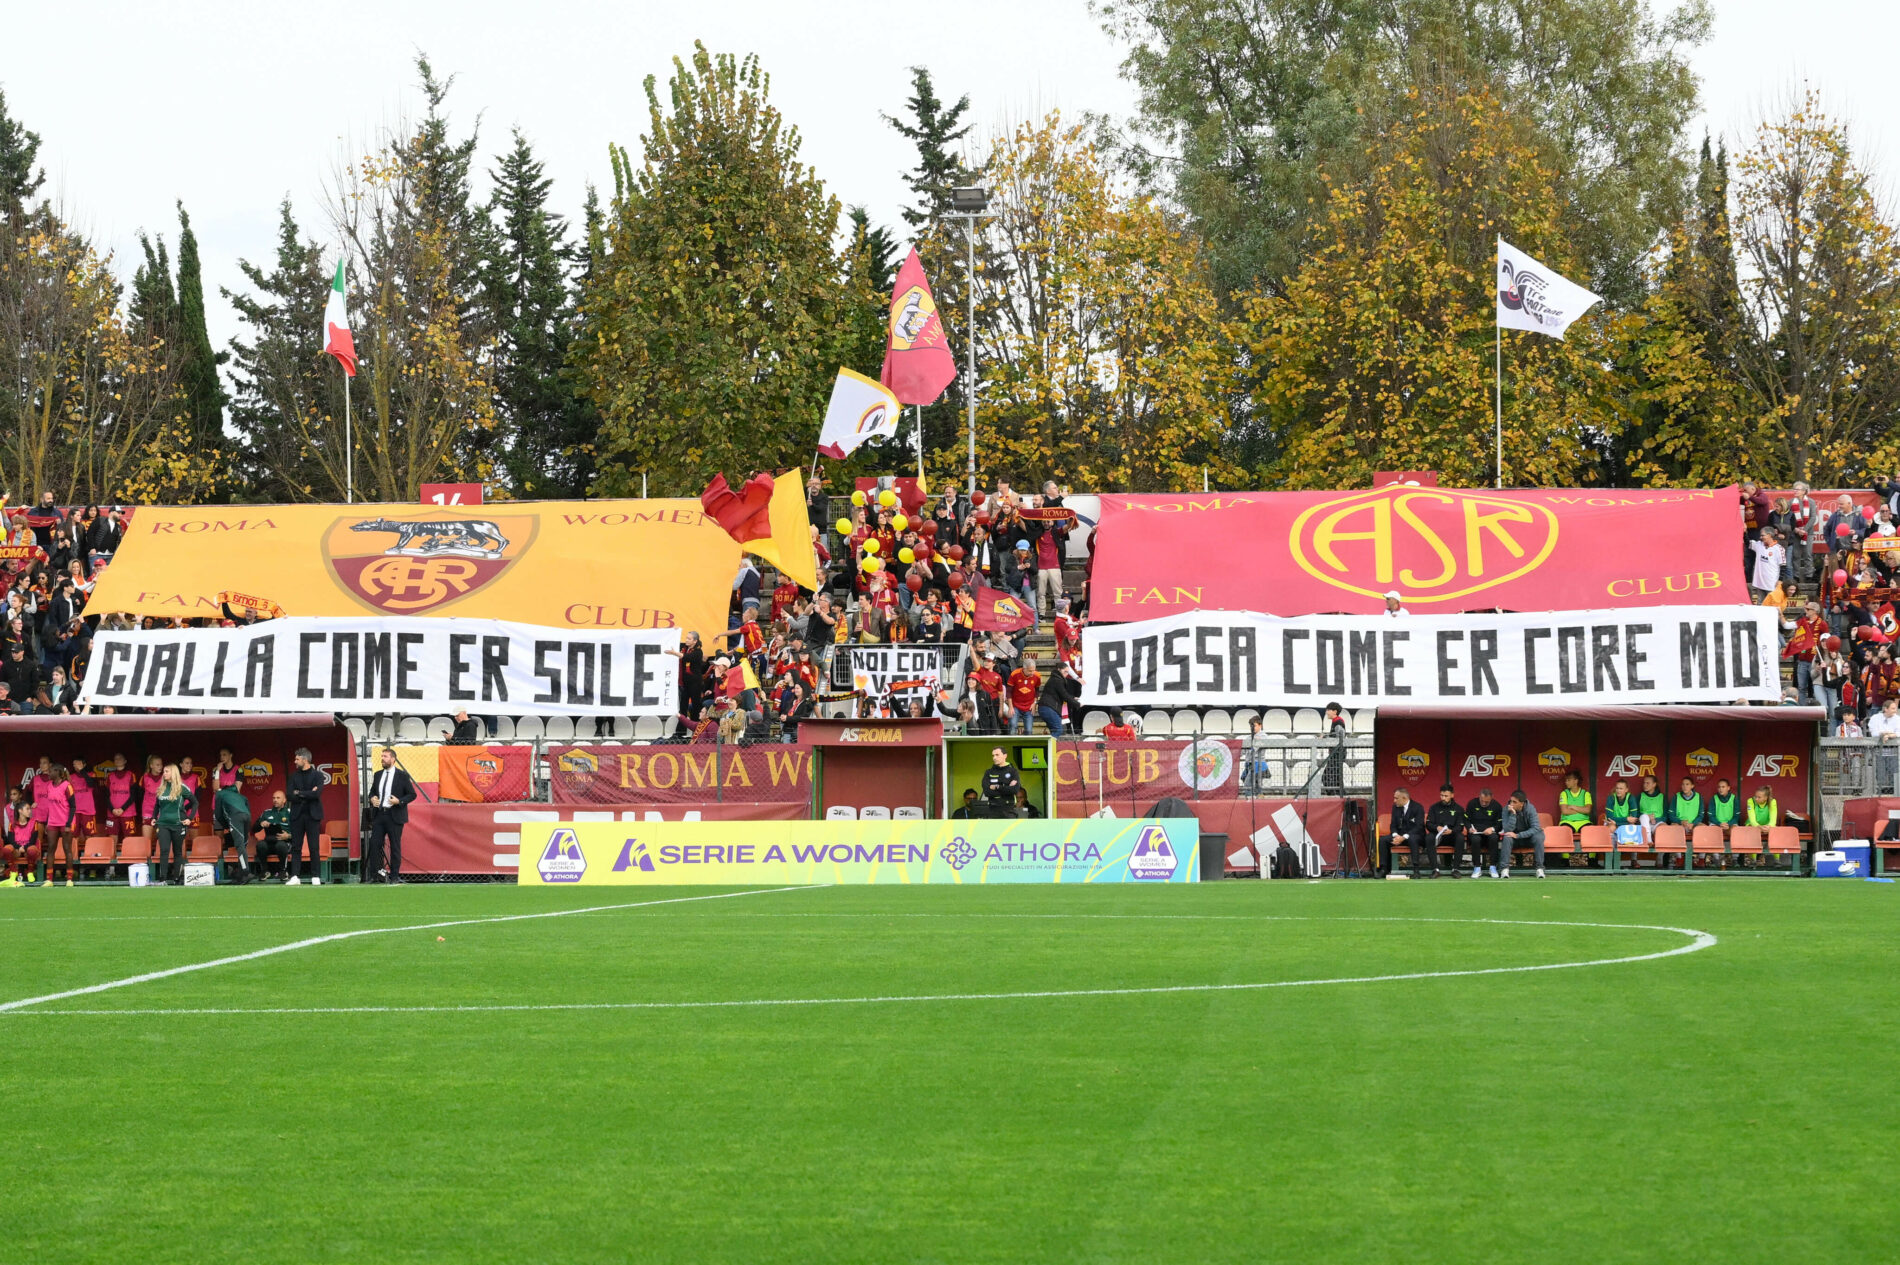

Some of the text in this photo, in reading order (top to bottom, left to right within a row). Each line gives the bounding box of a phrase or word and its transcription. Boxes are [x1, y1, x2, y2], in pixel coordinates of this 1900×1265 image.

[1125, 489, 1715, 512] ROMA WOMEN
[152, 509, 721, 535] ROMA WOMEN
[1042, 509, 1068, 517] ROMA
[1313, 492, 1533, 588] ASR
[1112, 587, 1206, 604] FAN
[1606, 571, 1723, 598] CLUB
[136, 592, 676, 629] FAN CLUB
[96, 632, 662, 707] GIALLA COME ER SOLE
[853, 649, 938, 672] NOI CON
[1097, 626, 1257, 696] ROSSA
[1282, 628, 1411, 697] COME
[1436, 629, 1499, 696] ER
[1524, 623, 1655, 695] CORE
[1679, 620, 1761, 690] MIO
[311, 763, 349, 785] SR
[618, 751, 753, 789] ROMA
[1055, 748, 1160, 785] CLUB
[1402, 768, 1425, 776] ROMA
[1460, 754, 1512, 777] ASR
[1542, 767, 1566, 775] ROMA
[1605, 754, 1658, 777] ASR
[1689, 767, 1713, 775] ROMA
[1746, 754, 1800, 777] ASR
[565, 775, 593, 783] ROMA
[659, 844, 930, 864] SERIE A WOMEN
[983, 842, 1103, 862] ATHORA
